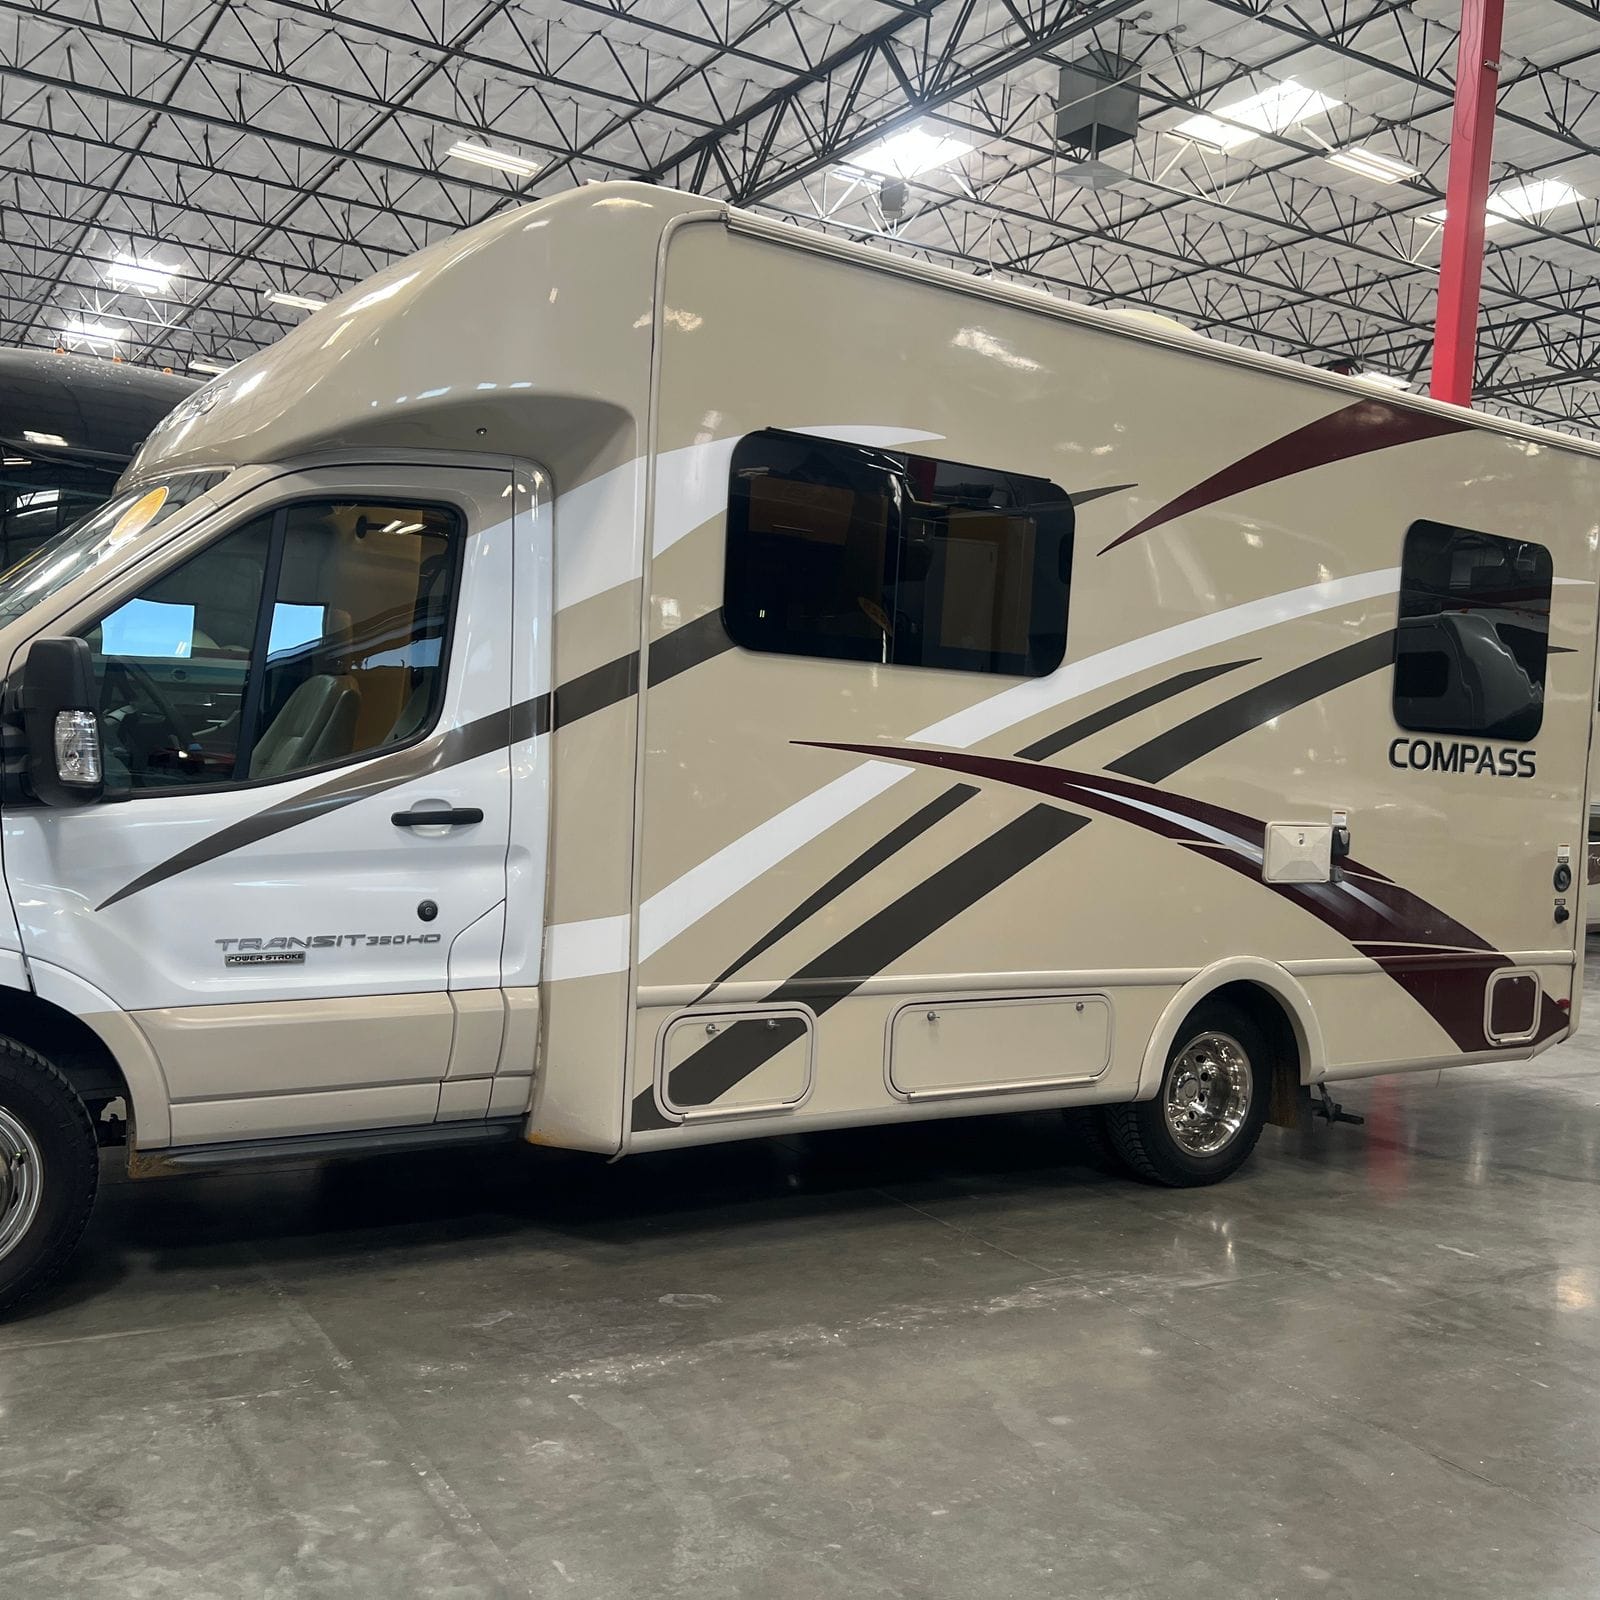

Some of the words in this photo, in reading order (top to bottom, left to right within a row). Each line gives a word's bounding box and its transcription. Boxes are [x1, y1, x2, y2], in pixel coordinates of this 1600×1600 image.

[1389, 738, 1536, 778] COMPASS
[215, 934, 366, 952] TRANSIT
[366, 933, 441, 946] 350HD
[227, 954, 263, 962] POWER
[265, 953, 304, 961] STROKE
